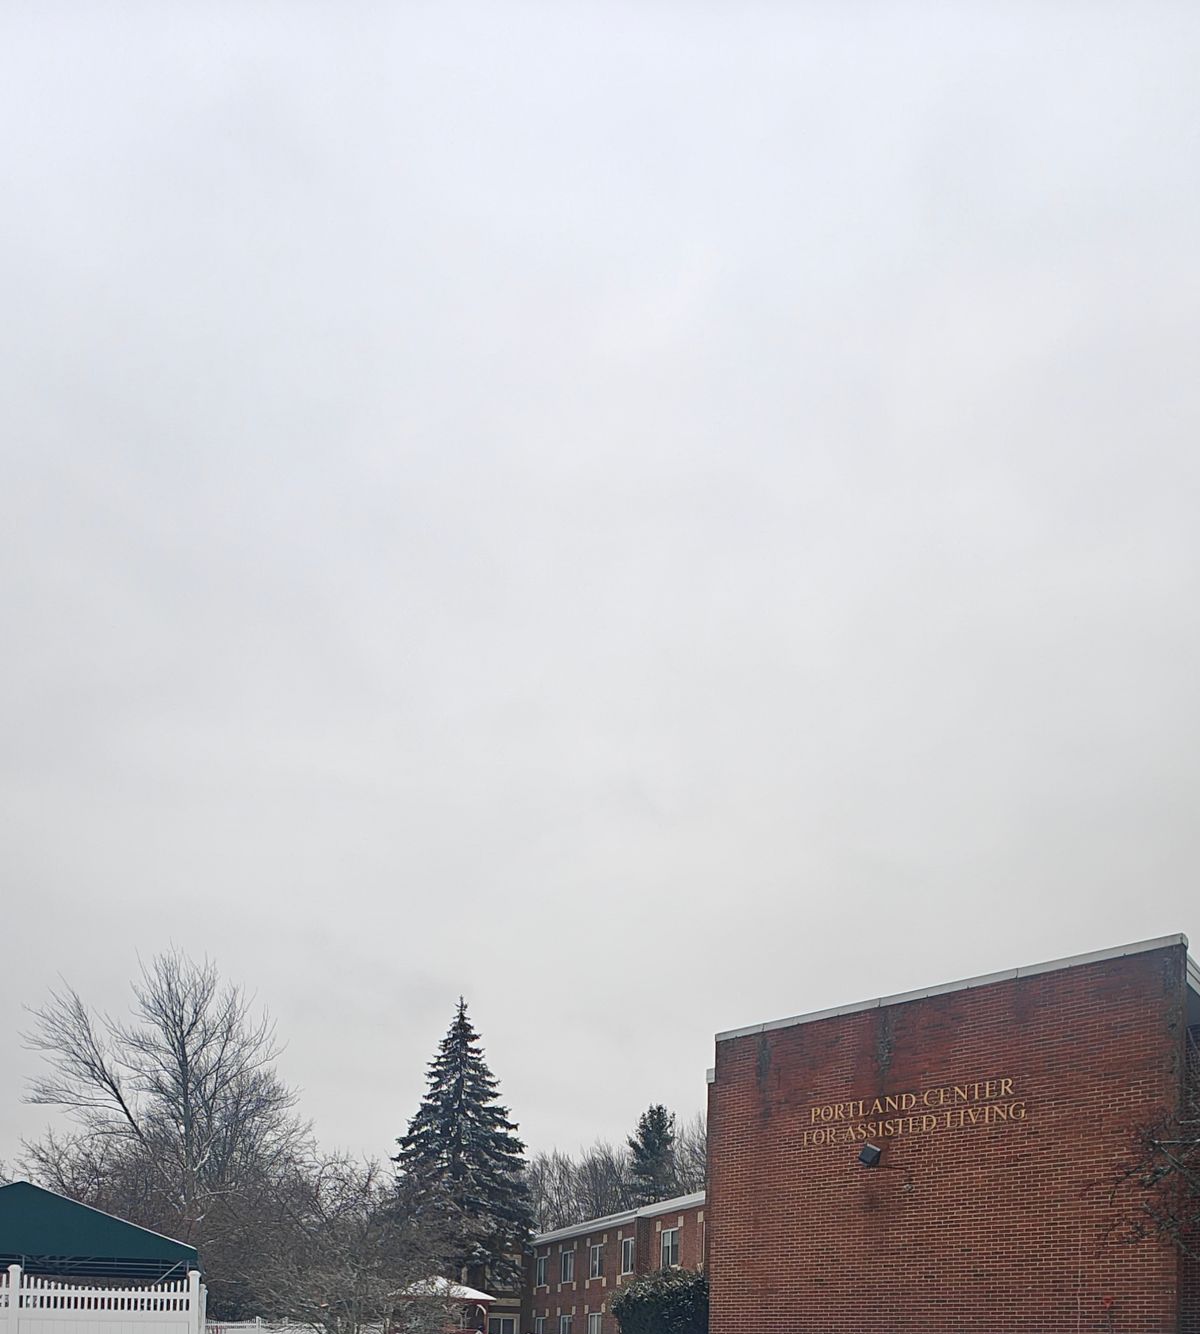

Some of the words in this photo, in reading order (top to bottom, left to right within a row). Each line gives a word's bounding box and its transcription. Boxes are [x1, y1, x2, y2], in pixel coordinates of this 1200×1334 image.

[803, 1129, 838, 1146] FOR
[844, 1114, 937, 1142] ASSISTED
[946, 1101, 1027, 1129] LIVING
[811, 1093, 916, 1124] PORTLAND
[923, 1078, 1014, 1107] CENTER
